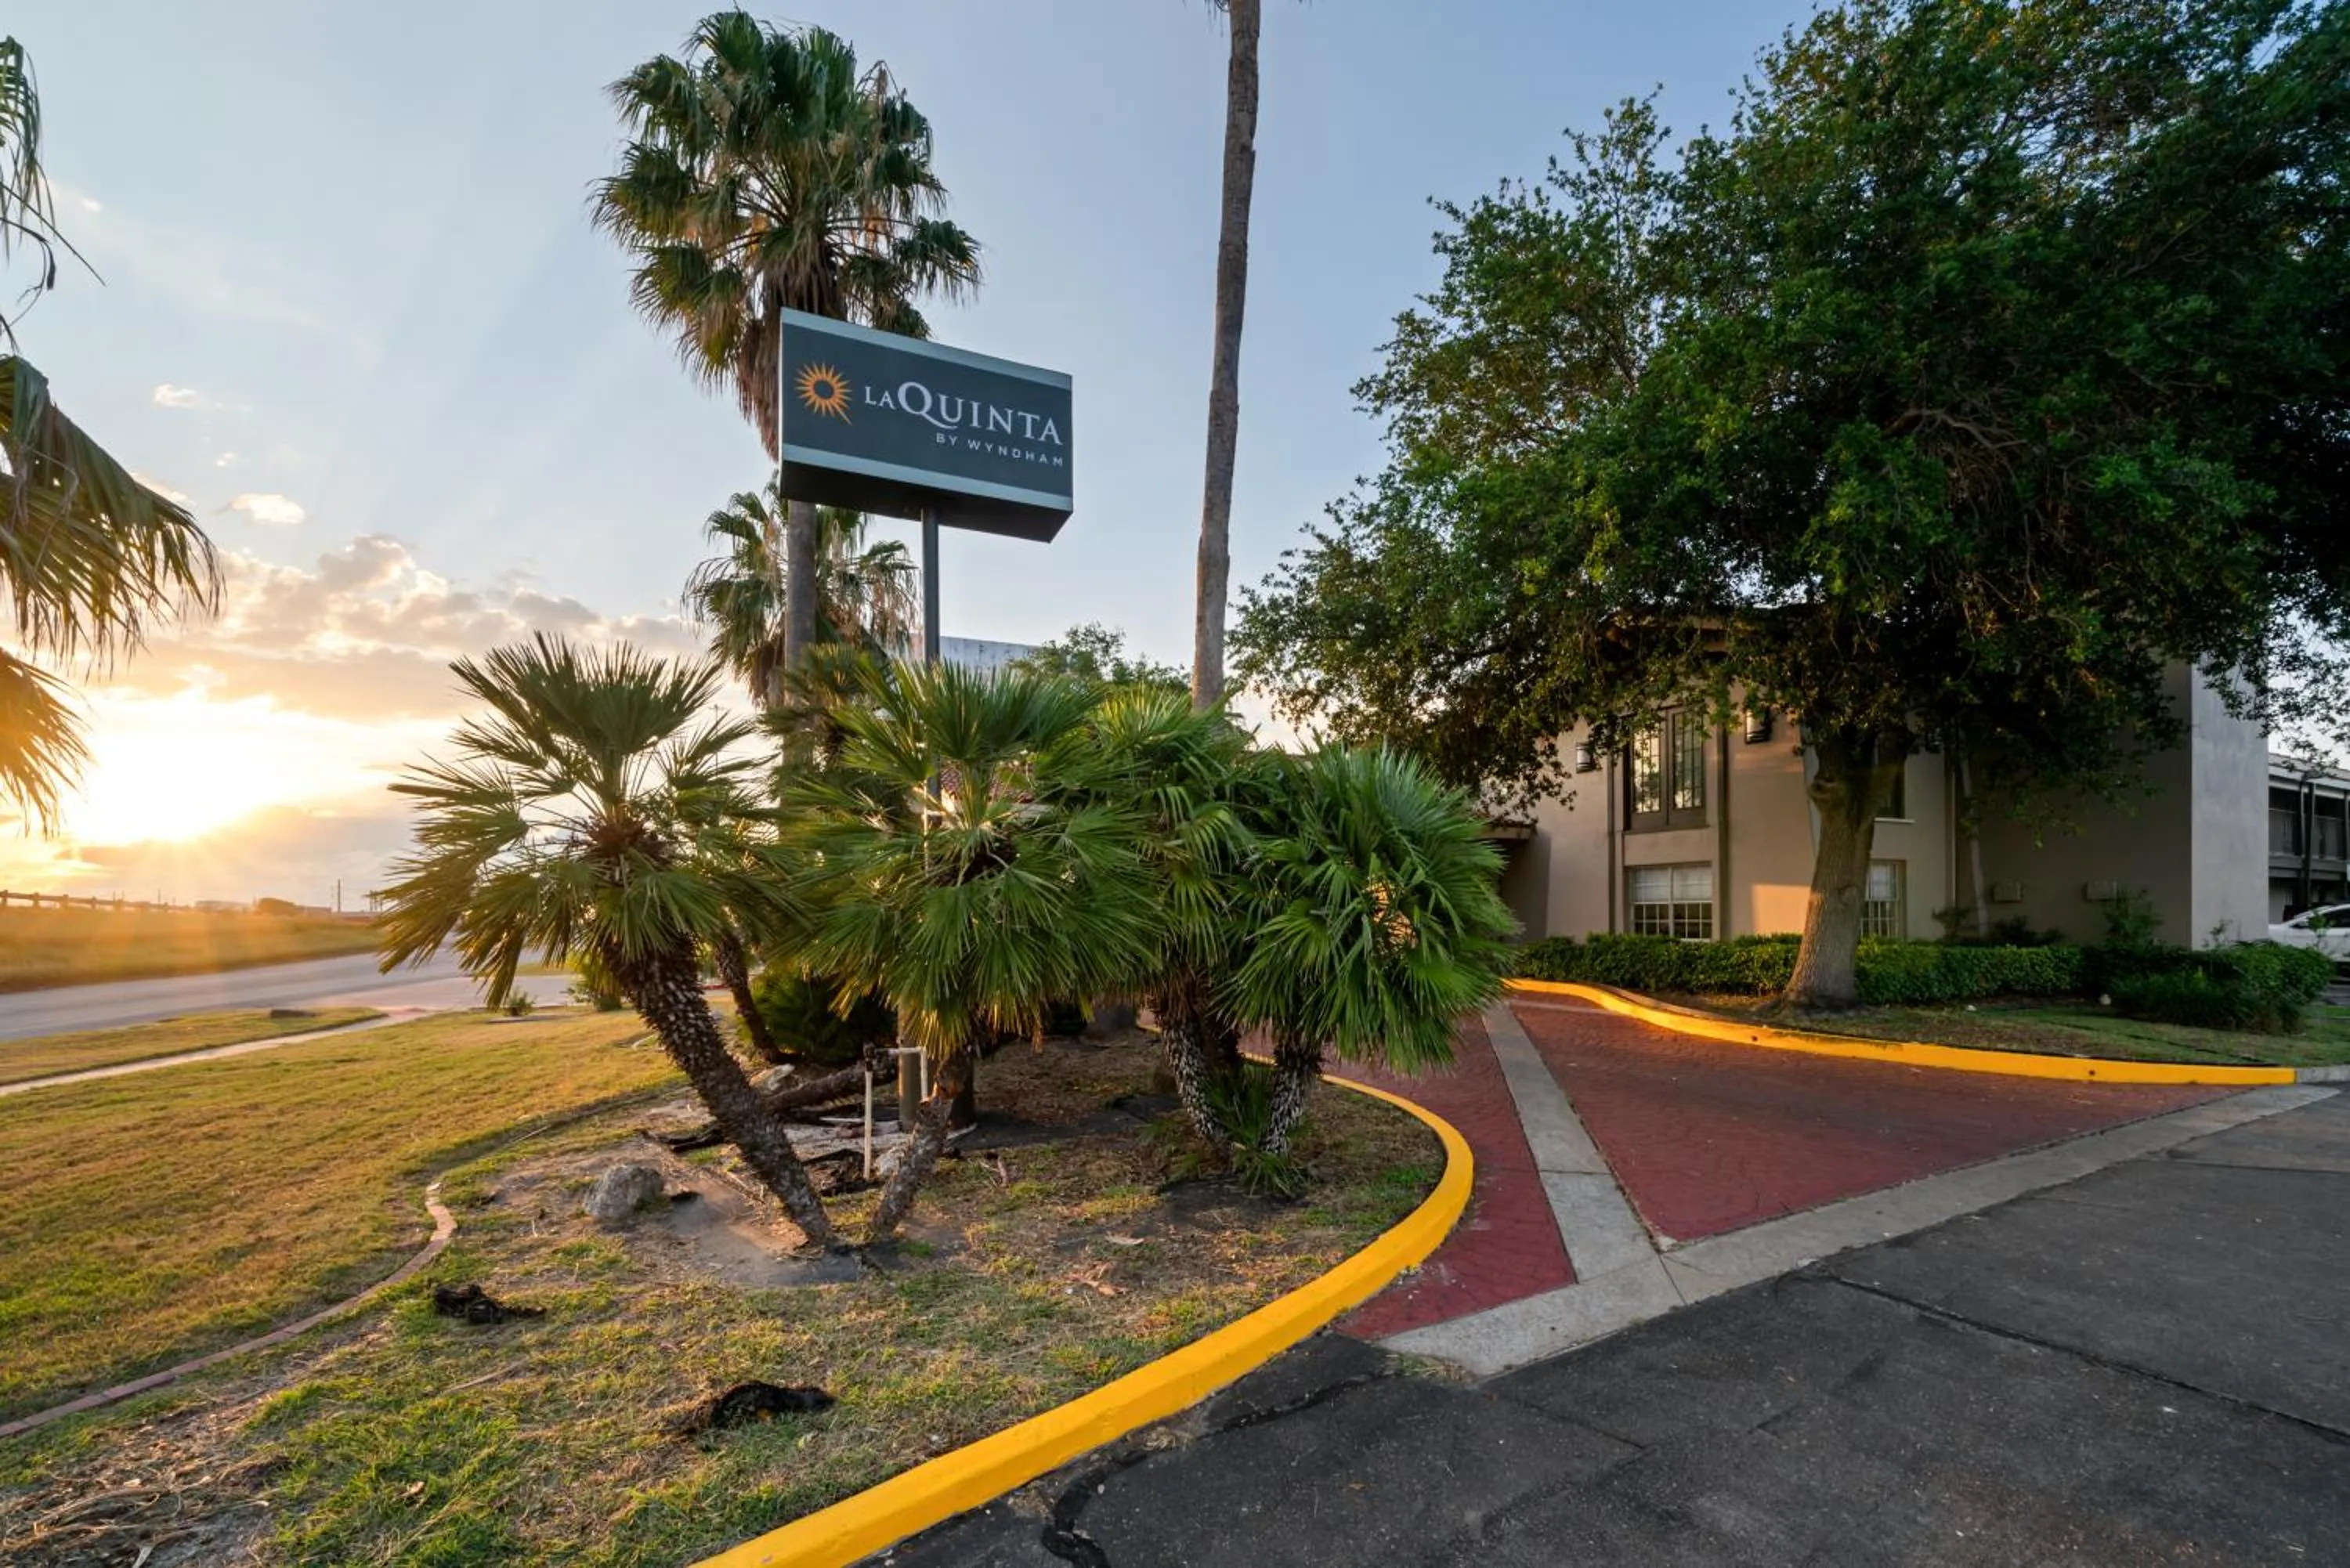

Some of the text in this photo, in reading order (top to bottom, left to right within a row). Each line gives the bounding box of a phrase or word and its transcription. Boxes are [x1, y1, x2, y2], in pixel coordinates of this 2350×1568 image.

[864, 381, 1063, 445] LA QUINTA
[936, 432, 1063, 467] BY WYNDHAM
